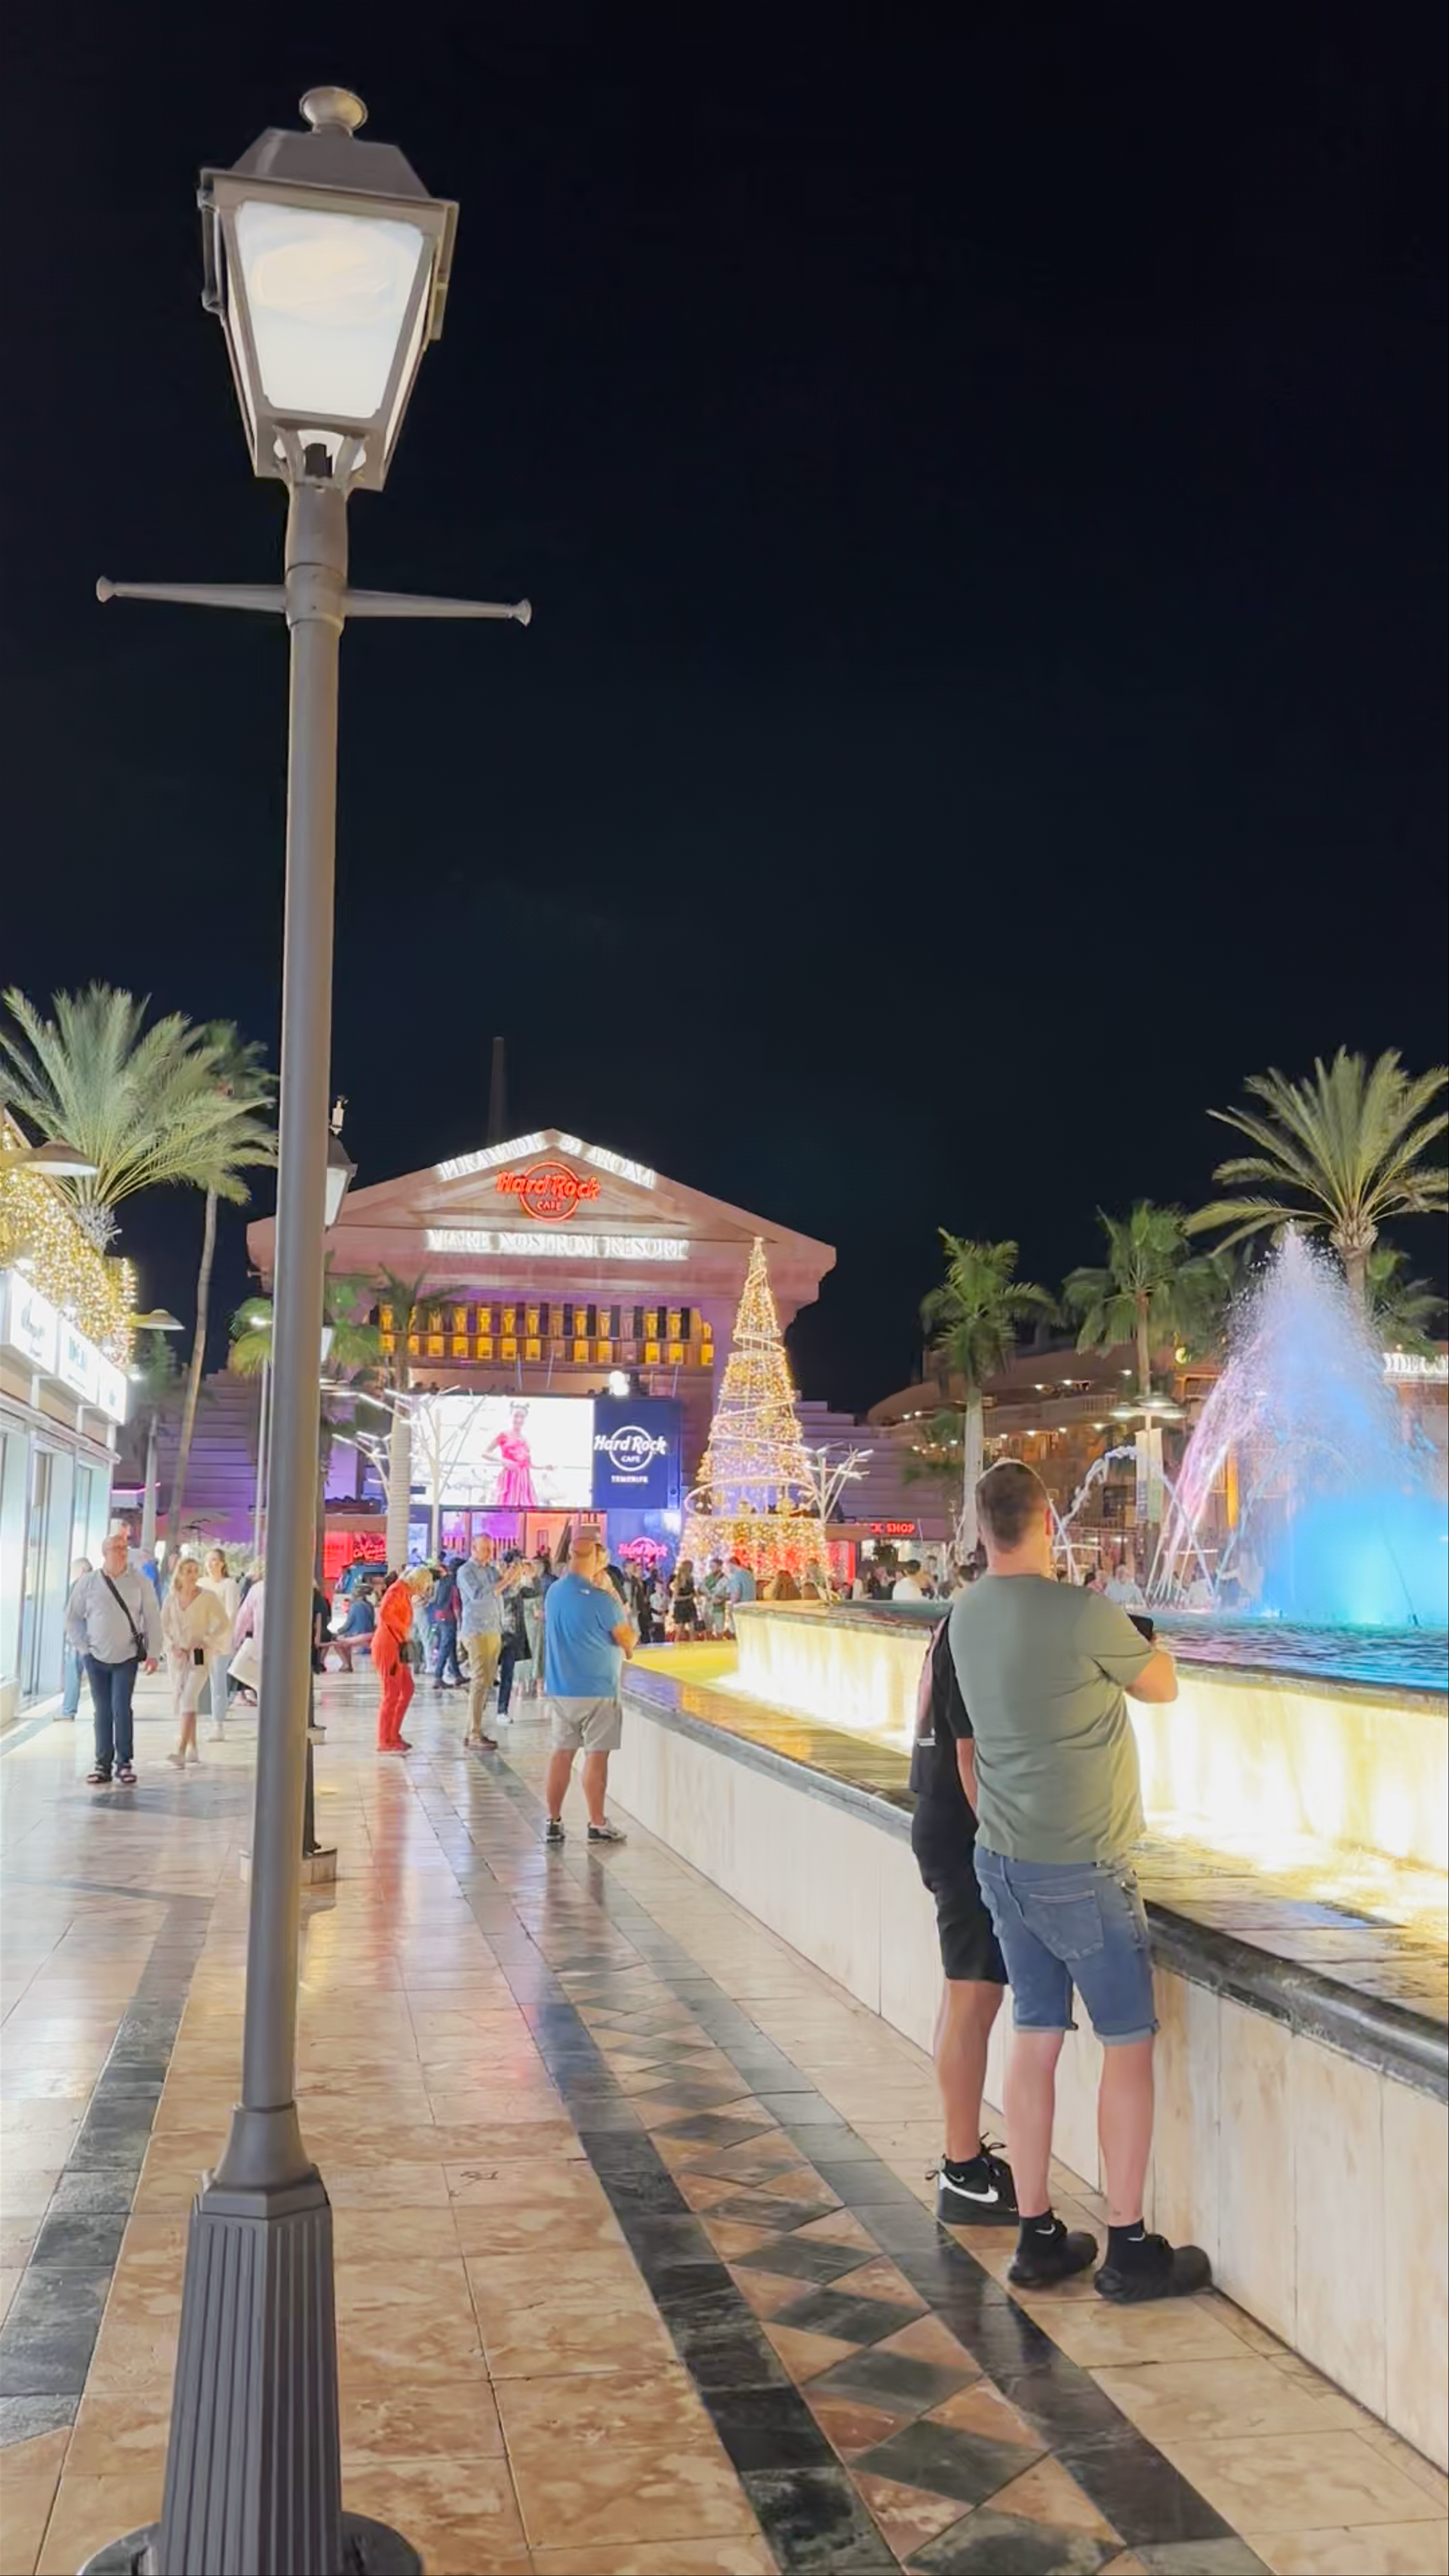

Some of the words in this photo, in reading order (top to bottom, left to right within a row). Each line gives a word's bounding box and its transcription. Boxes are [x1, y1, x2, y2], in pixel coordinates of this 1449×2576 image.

[497, 1172, 551, 1194] Hard
[552, 1175, 601, 1200] Rock
[537, 1201, 561, 1210] CAFE
[594, 1435, 631, 1450] Hard
[631, 1435, 667, 1455] Rock
[611, 1475, 648, 1483] TENERIFE
[887, 1523, 915, 1532] SHOP
